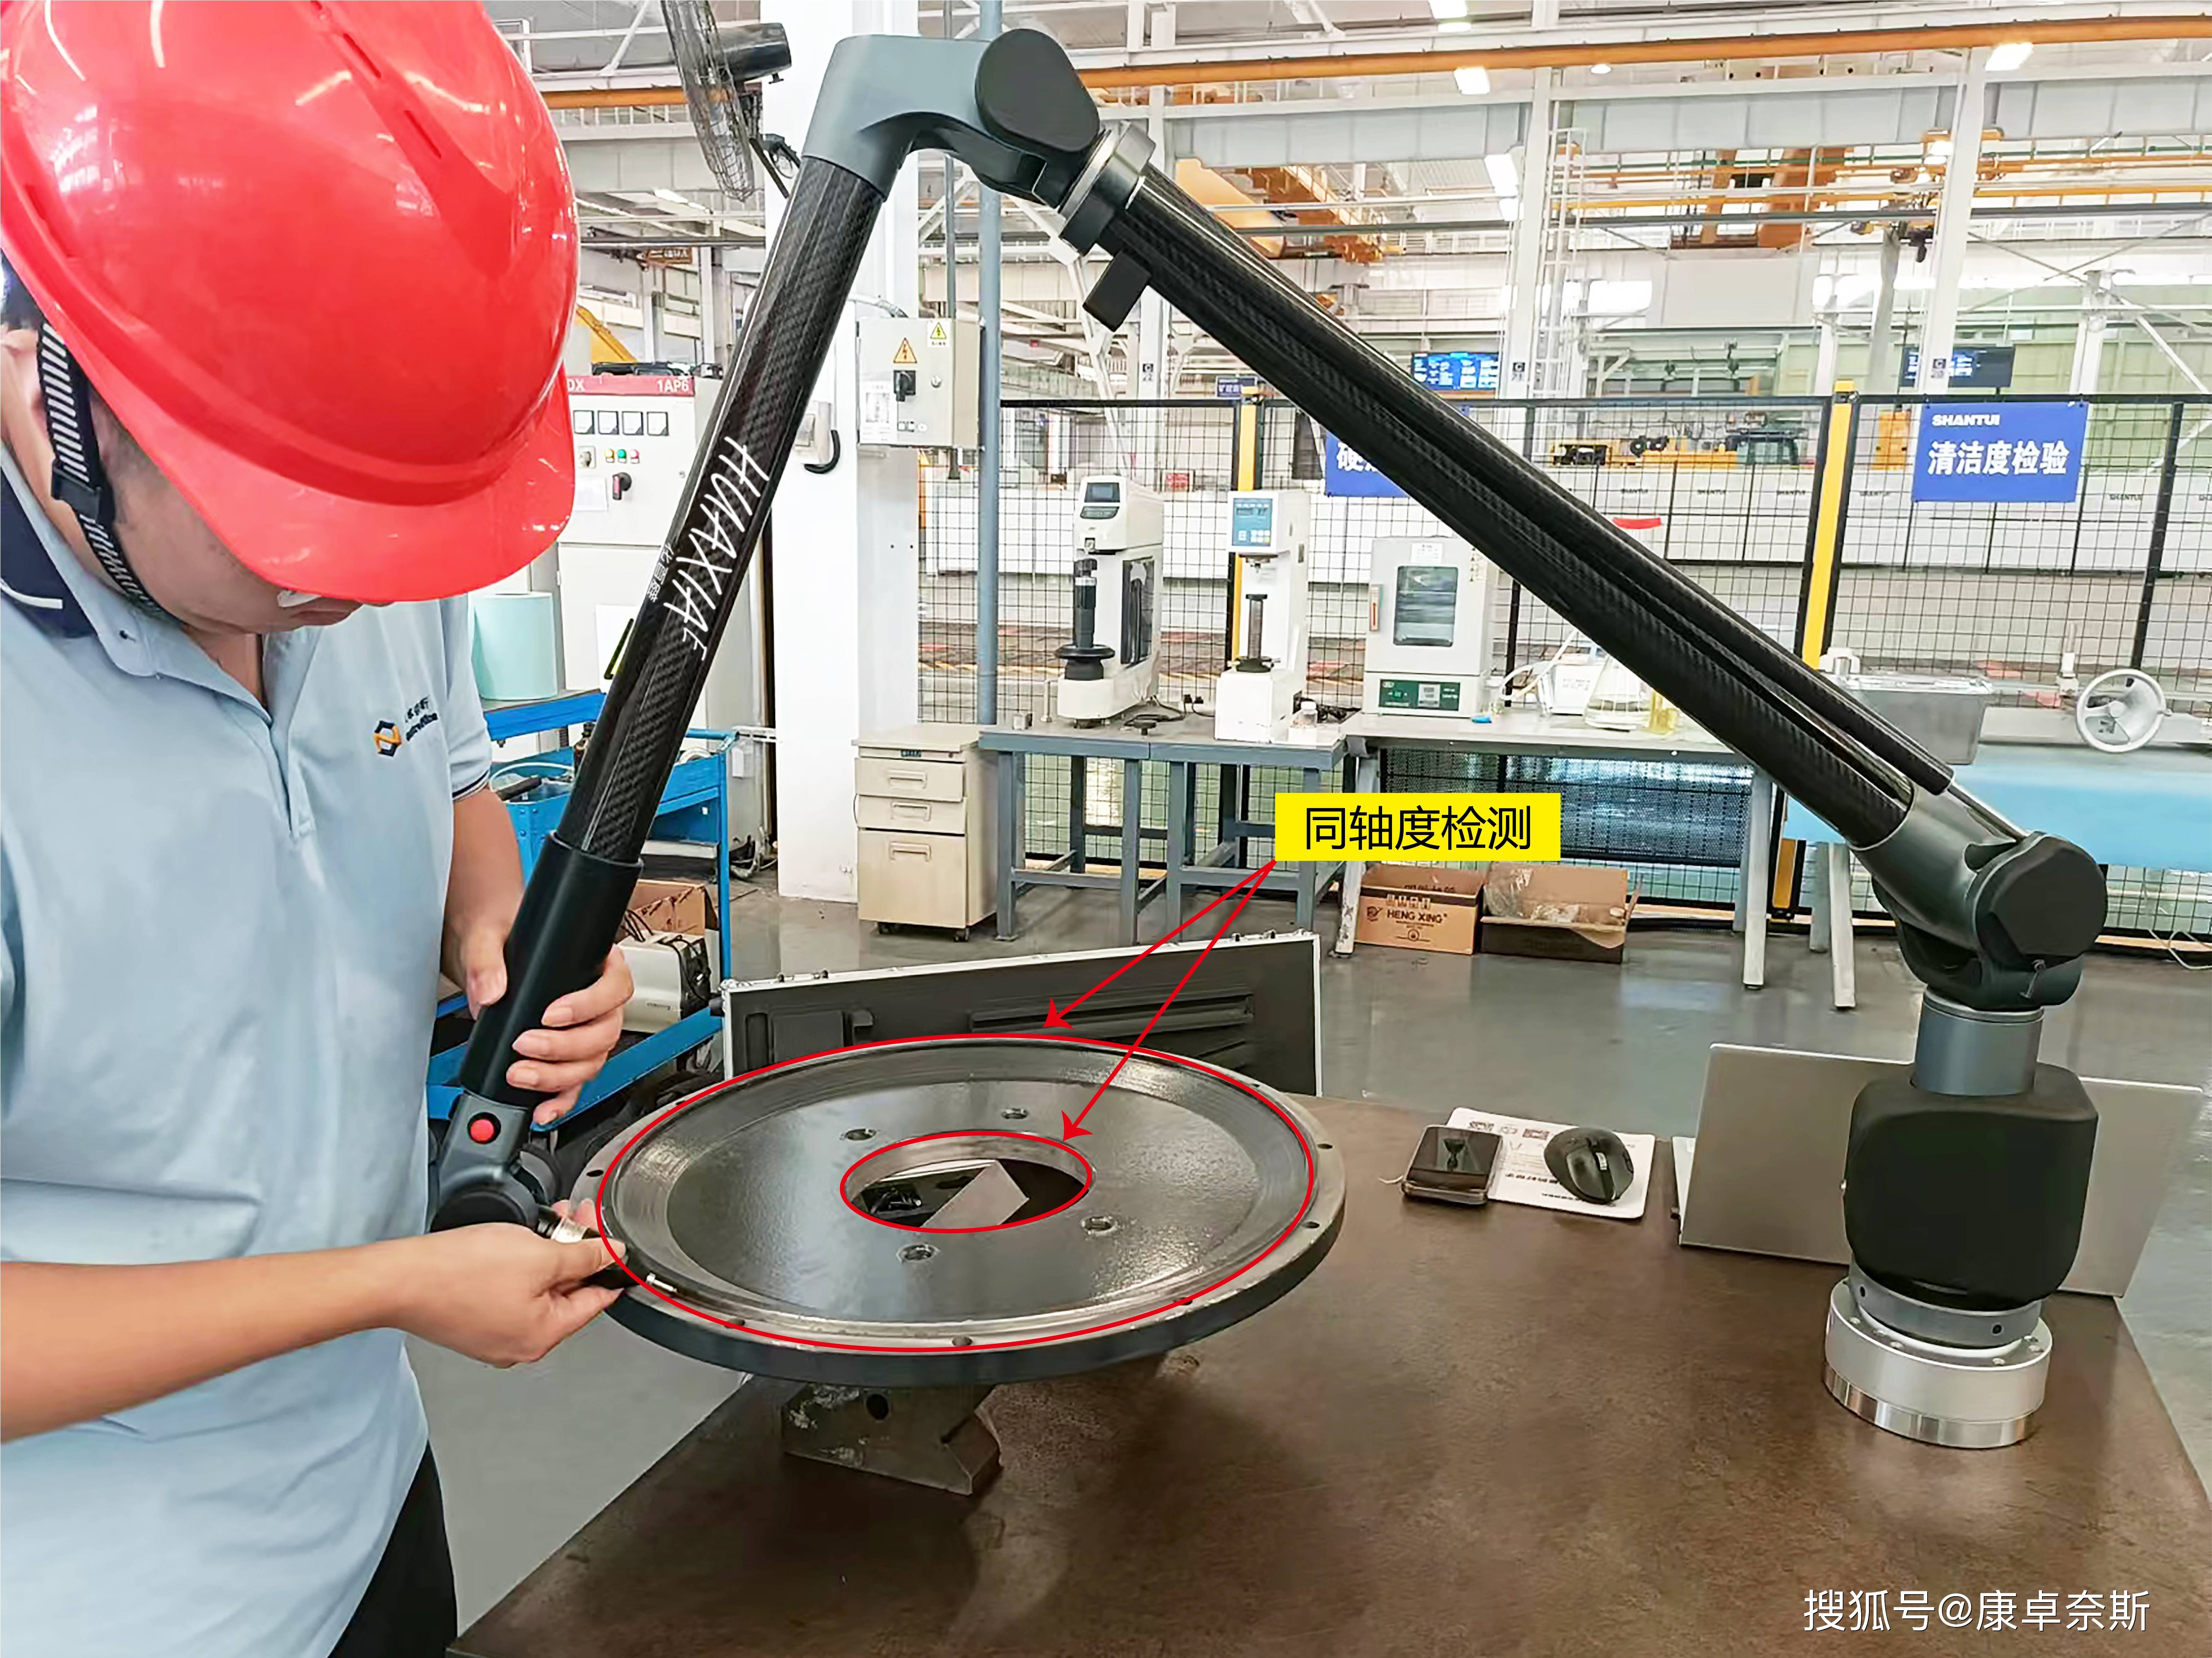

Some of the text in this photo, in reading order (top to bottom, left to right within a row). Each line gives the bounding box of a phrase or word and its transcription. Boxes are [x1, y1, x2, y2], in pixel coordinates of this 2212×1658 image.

[1932, 415, 2000, 426] SHANTUI
[1336, 442, 1379, 472] 硬
[1928, 440, 2070, 475] 清洁度检验
[1387, 910, 1415, 920] HENG
